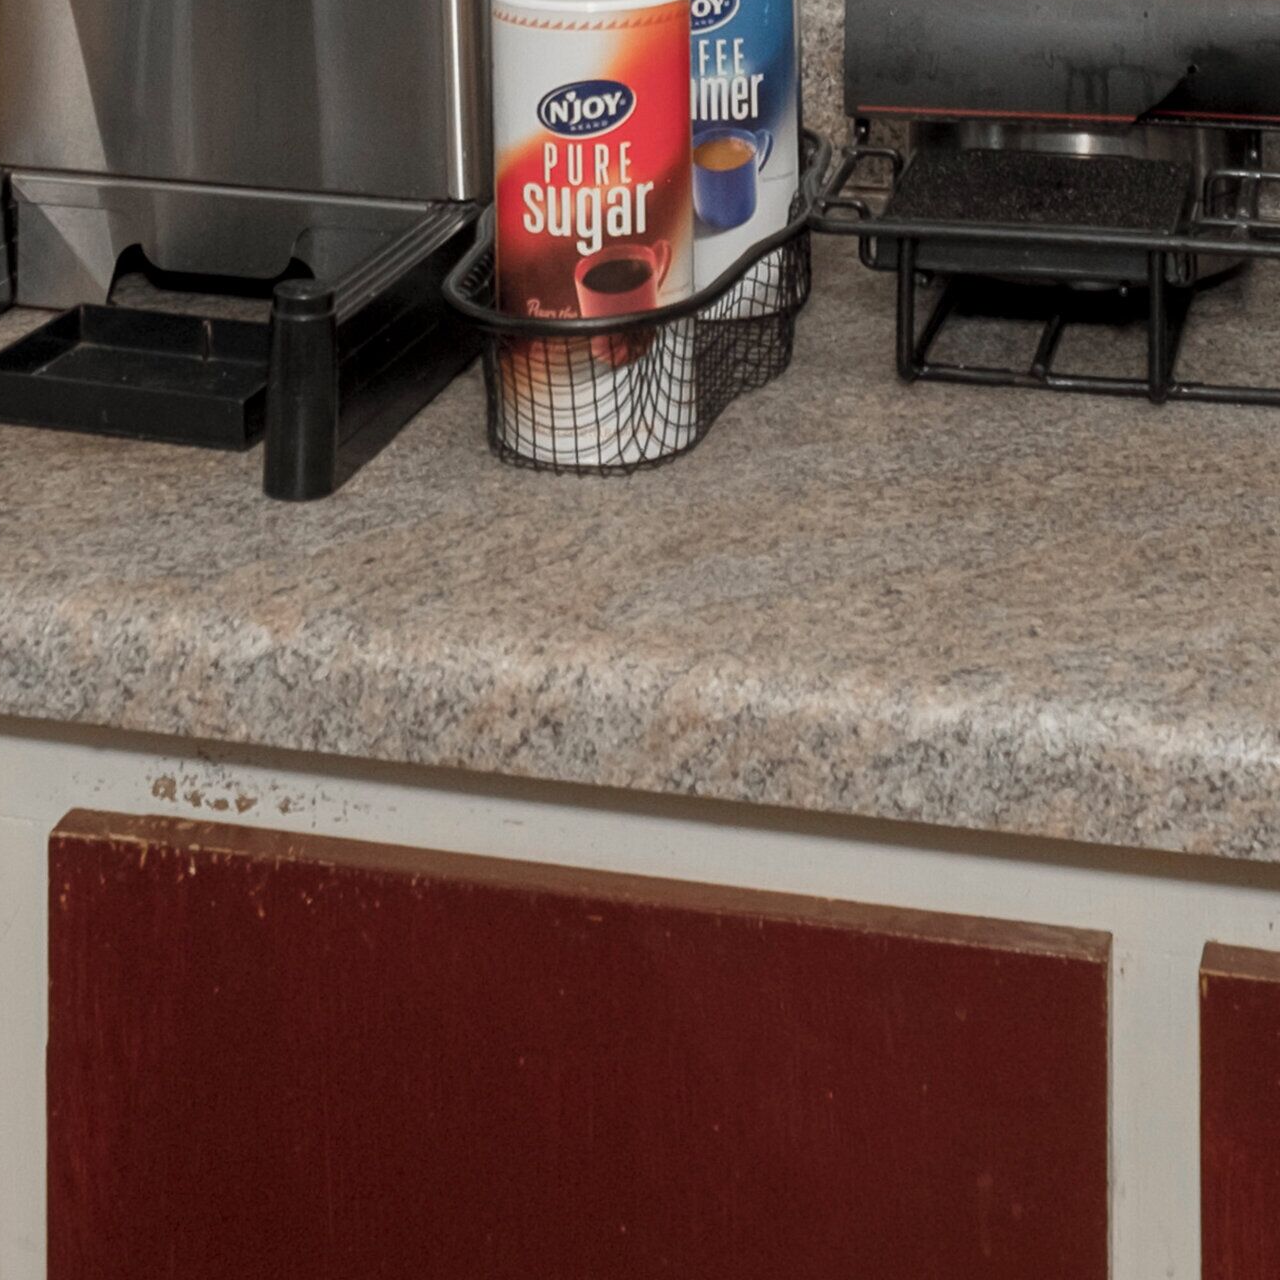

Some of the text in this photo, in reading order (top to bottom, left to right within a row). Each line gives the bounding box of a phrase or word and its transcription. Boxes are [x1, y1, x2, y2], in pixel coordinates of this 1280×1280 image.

[698, 37, 745, 76] FEE
[544, 141, 632, 186] PURE
[523, 180, 654, 257] sugar
